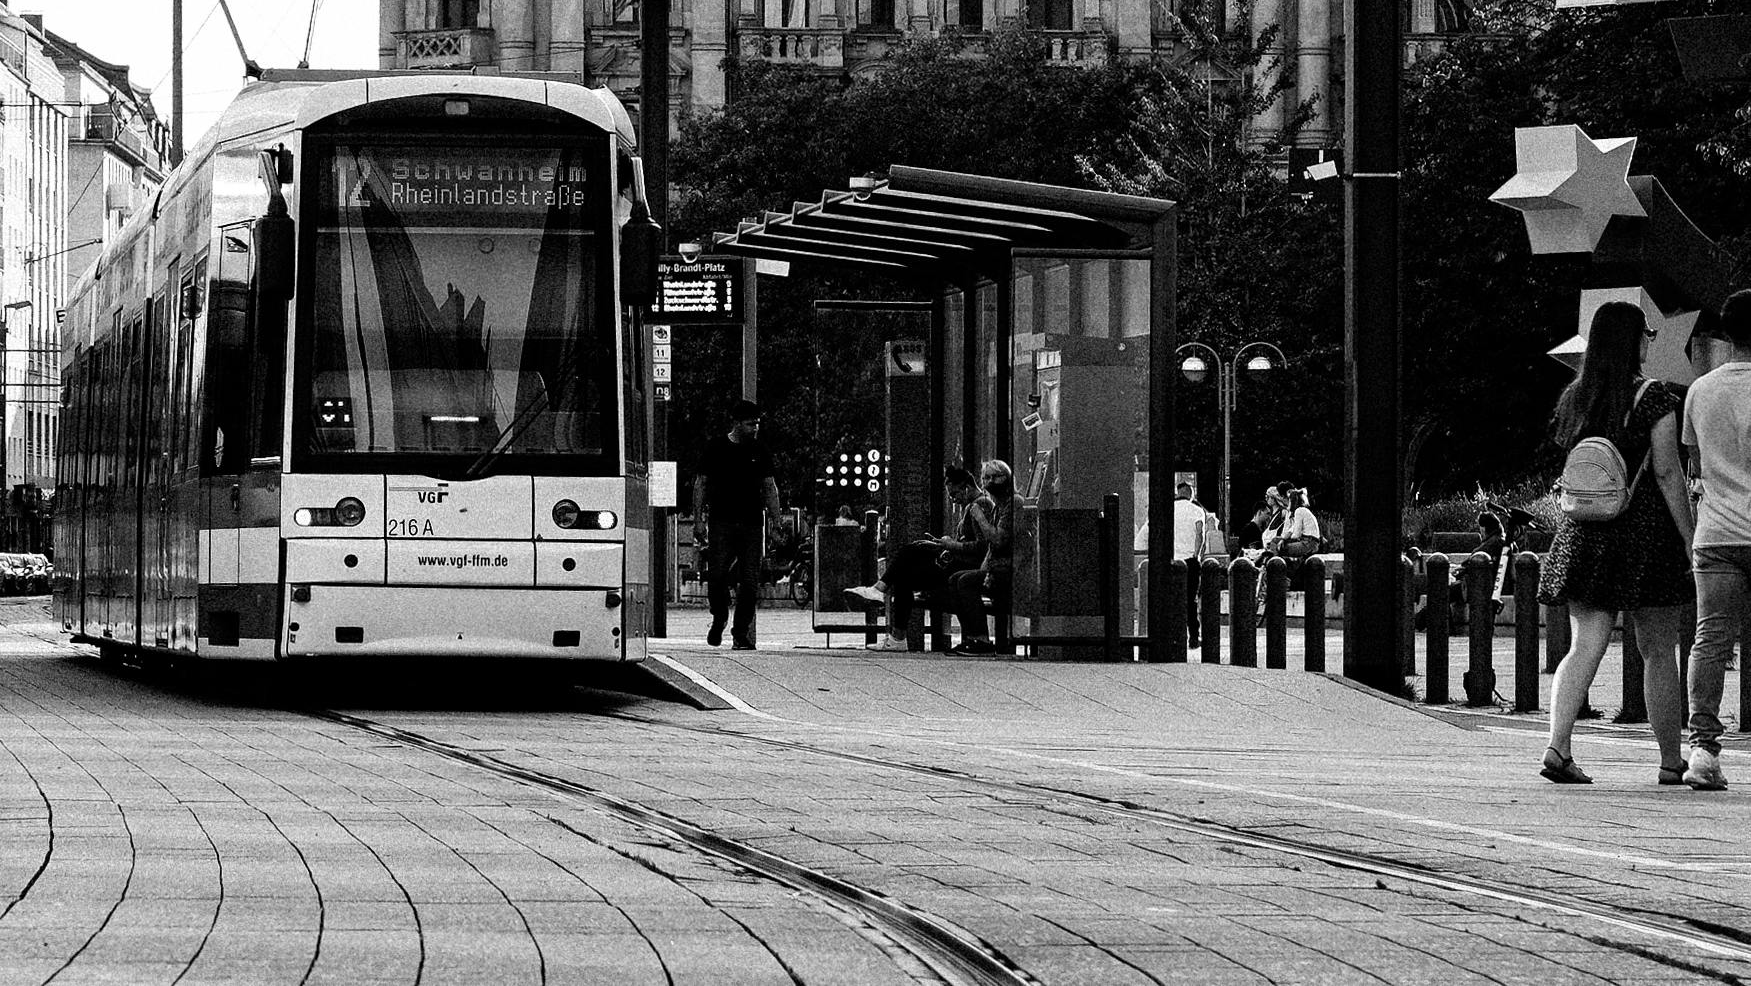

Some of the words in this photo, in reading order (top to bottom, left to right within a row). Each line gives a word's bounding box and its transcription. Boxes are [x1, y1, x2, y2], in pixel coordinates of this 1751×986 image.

[391, 182, 585, 210] Rheinlandstraße
[658, 263, 726, 274] illy-Brandt-Platz
[656, 349, 665, 357] 11
[656, 368, 666, 376] 12
[418, 491, 449, 504] VGF
[388, 518, 419, 536] 216
[422, 518, 434, 536] A
[417, 553, 508, 569] www.vgf-ffm.de
